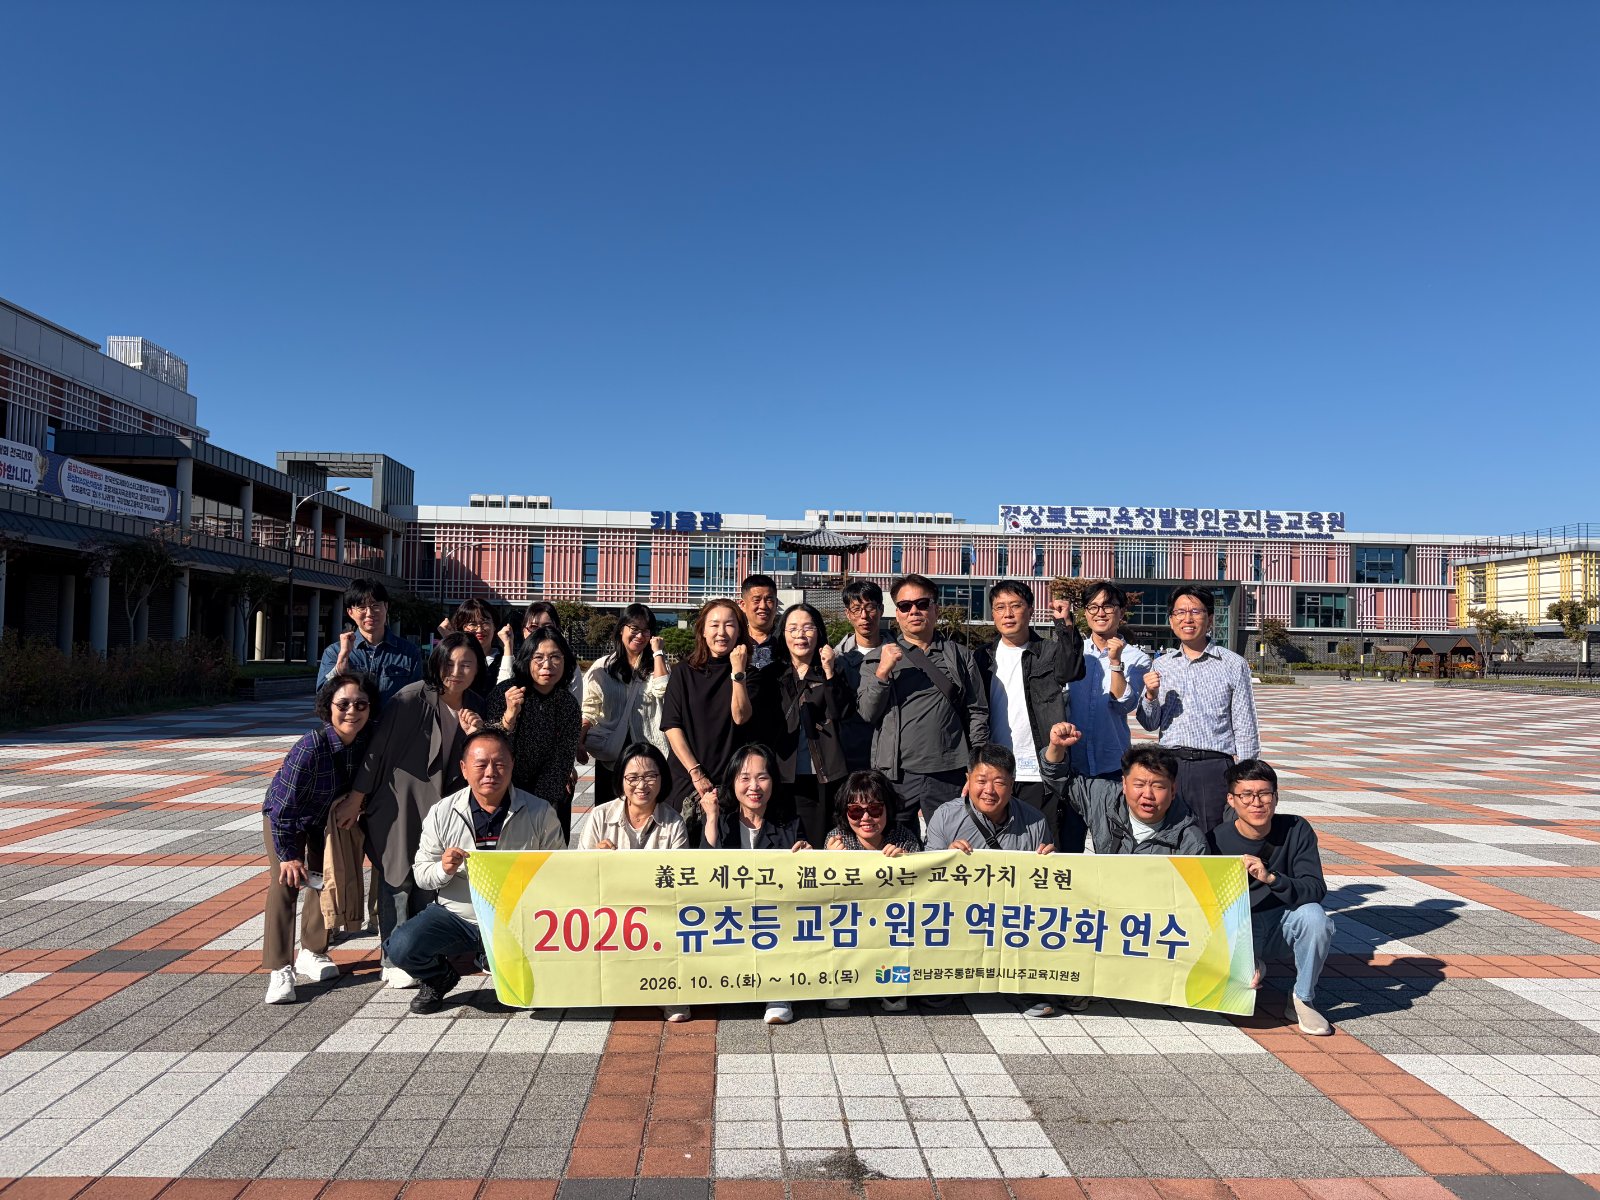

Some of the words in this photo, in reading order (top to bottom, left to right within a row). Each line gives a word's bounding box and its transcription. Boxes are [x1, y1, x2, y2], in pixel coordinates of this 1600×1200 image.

[10, 447, 33, 462] 전국대회
[1001, 506, 1345, 533] 경상북도교육청발명인공지능교육원
[1086, 527, 1108, 535] Office
[1109, 527, 1118, 535] of
[1118, 528, 1156, 536] Education
[1267, 531, 1304, 539] Education
[655, 864, 699, 889] 義로
[709, 864, 784, 890] 세우고,
[875, 865, 918, 888] 잇는
[927, 863, 1016, 888] 교육가치
[1029, 866, 1073, 890] 실현
[534, 906, 662, 953] 2026.
[676, 904, 781, 953] 유초등
[965, 902, 1109, 952] 역량강화
[1120, 913, 1190, 960] 연수
[639, 977, 682, 991] 2026.
[690, 976, 713, 989] 10.
[720, 973, 762, 990] 6.(화)
[789, 973, 811, 986] 10.
[818, 968, 860, 985] 8.(목)
[912, 967, 1080, 983] 전남광주통합특별시나주교육지원청
